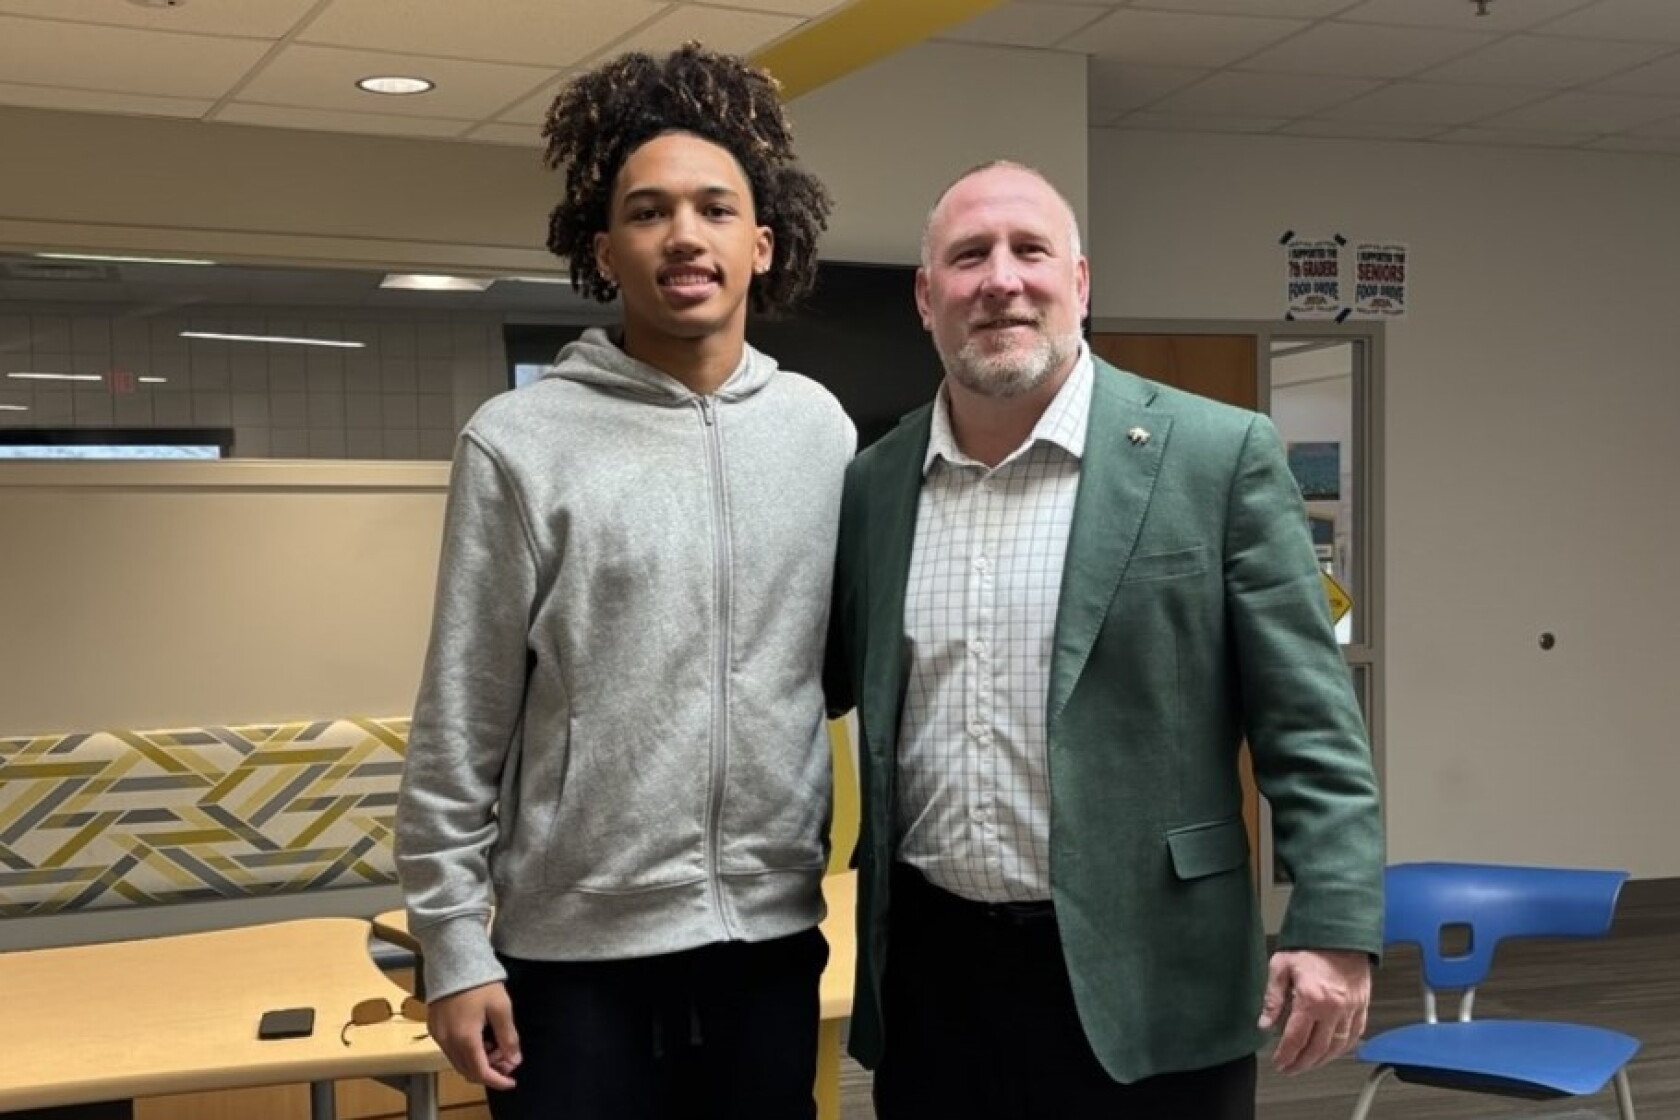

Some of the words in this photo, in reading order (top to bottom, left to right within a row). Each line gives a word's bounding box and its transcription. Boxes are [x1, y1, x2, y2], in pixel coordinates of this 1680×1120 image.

[1302, 261, 1338, 277] GRADERS
[1357, 264, 1404, 282] SENIORS
[1288, 282, 1312, 301] FOOD
[1313, 281, 1339, 300] DRIVE
[1356, 284, 1378, 303] FOOD
[1380, 285, 1404, 304] DRIVE
